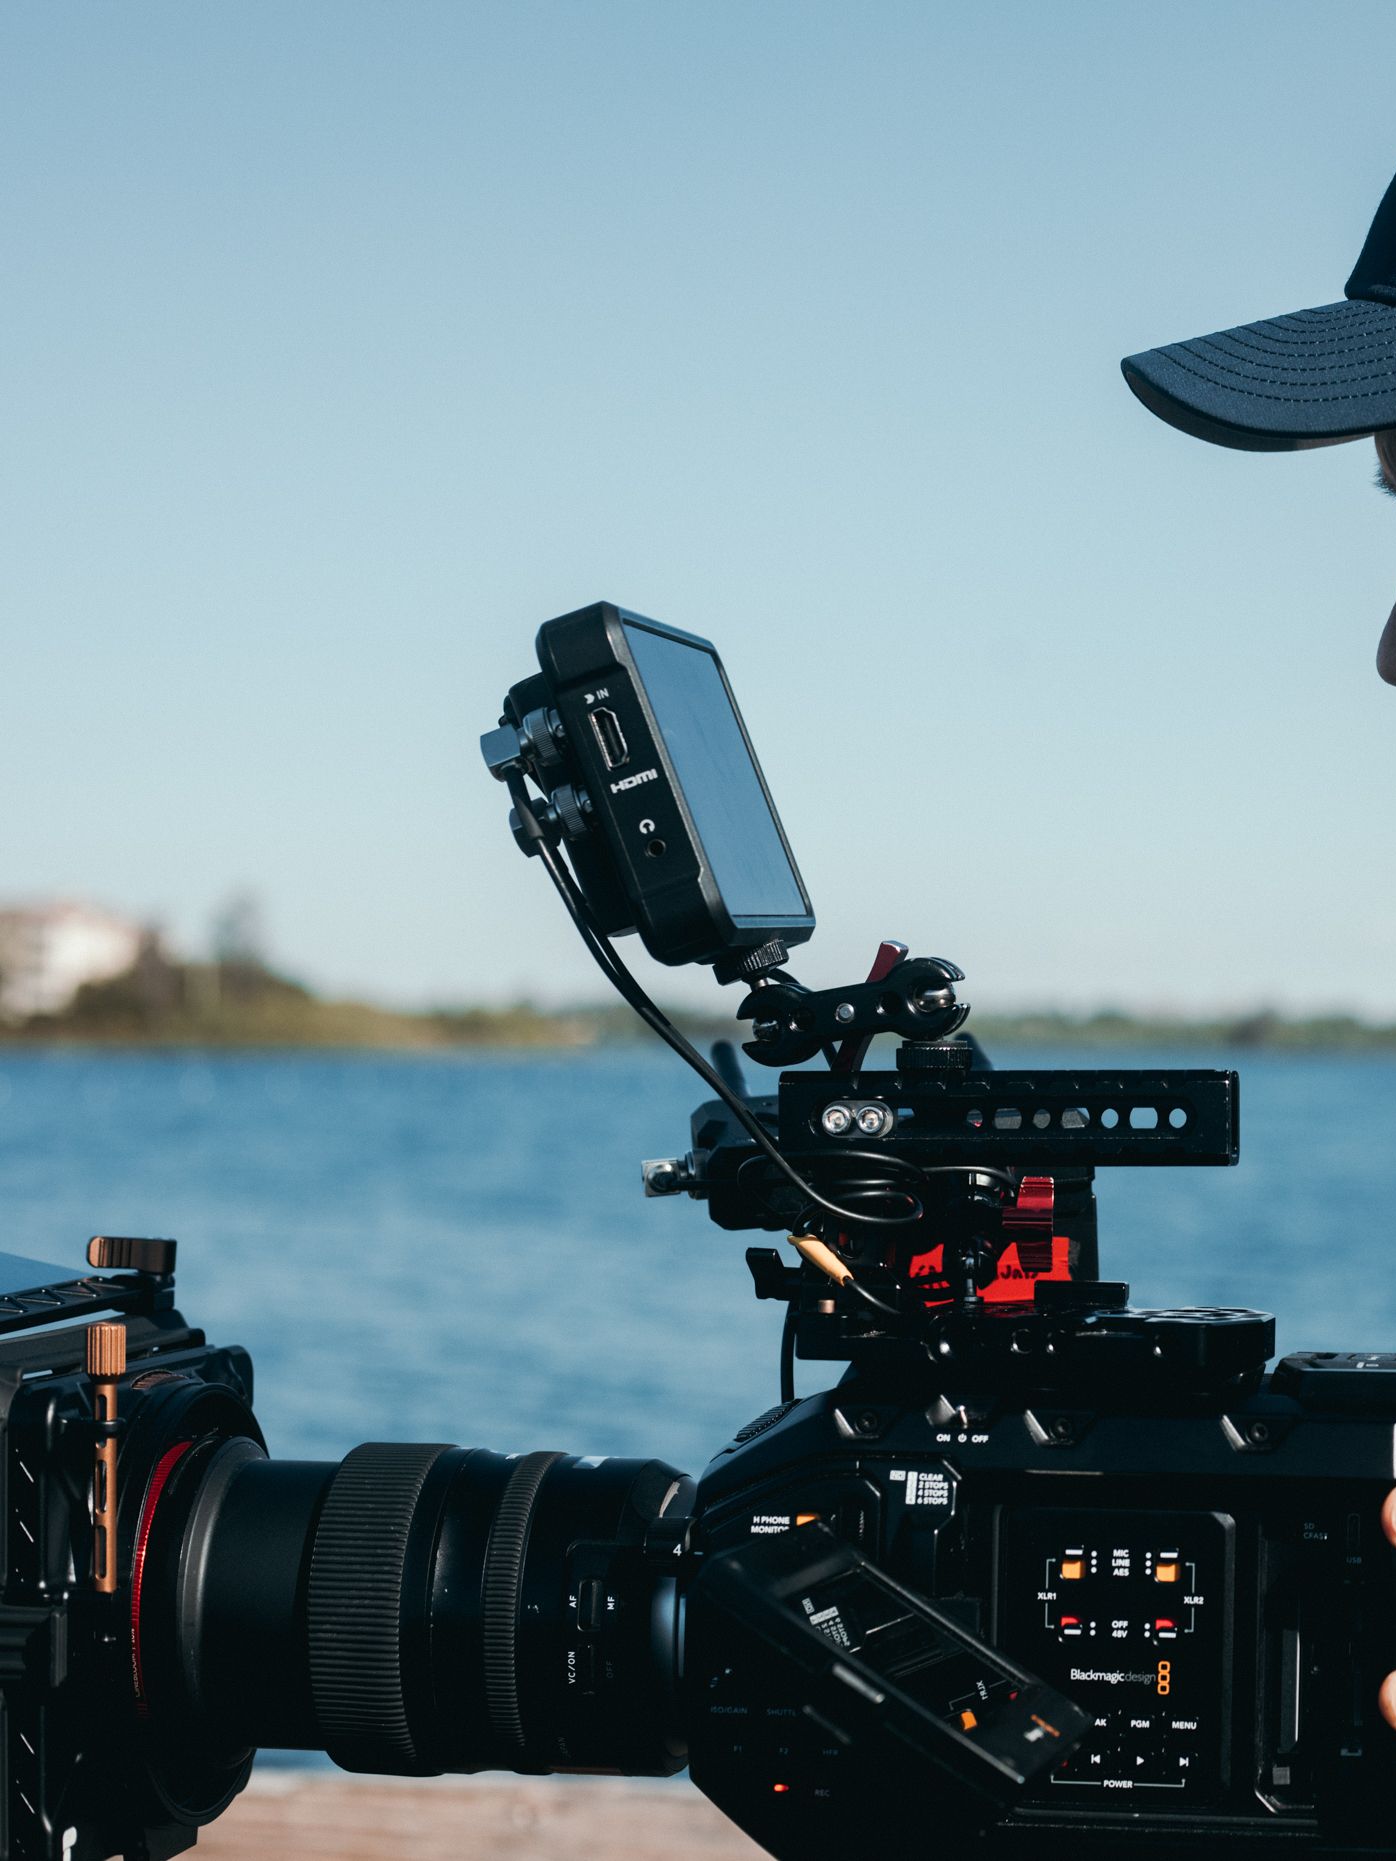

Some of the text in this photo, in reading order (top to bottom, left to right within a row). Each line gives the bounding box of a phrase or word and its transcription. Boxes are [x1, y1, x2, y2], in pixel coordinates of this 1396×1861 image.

[596, 688, 610, 700] IN
[609, 768, 658, 794] HDMI
[936, 1433, 951, 1443] ON
[971, 1434, 989, 1443] OFF
[919, 1472, 944, 1481] CLEAR
[918, 1481, 949, 1490] 2 STOPS
[917, 1488, 949, 1497] 4 STOPS
[923, 1496, 948, 1505] STOPS
[753, 1515, 790, 1525] H PHONE
[672, 1543, 682, 1557] 4
[1113, 1549, 1129, 1558] MIC
[1112, 1558, 1130, 1567] LINE
[1112, 1567, 1130, 1577] AES
[568, 1594, 577, 1608] AF
[1037, 1591, 1057, 1601] XLR1
[1183, 1595, 1204, 1605] XLR2
[607, 1596, 615, 1610] MF
[1112, 1620, 1129, 1629] OFF
[1111, 1629, 1128, 1639] 48V
[568, 1651, 576, 1684] VC/ON
[1094, 1718, 1107, 1727] AK
[1130, 1719, 1150, 1729] PGM
[1171, 1720, 1197, 1730] MENU
[1103, 1779, 1133, 1789] POWER
